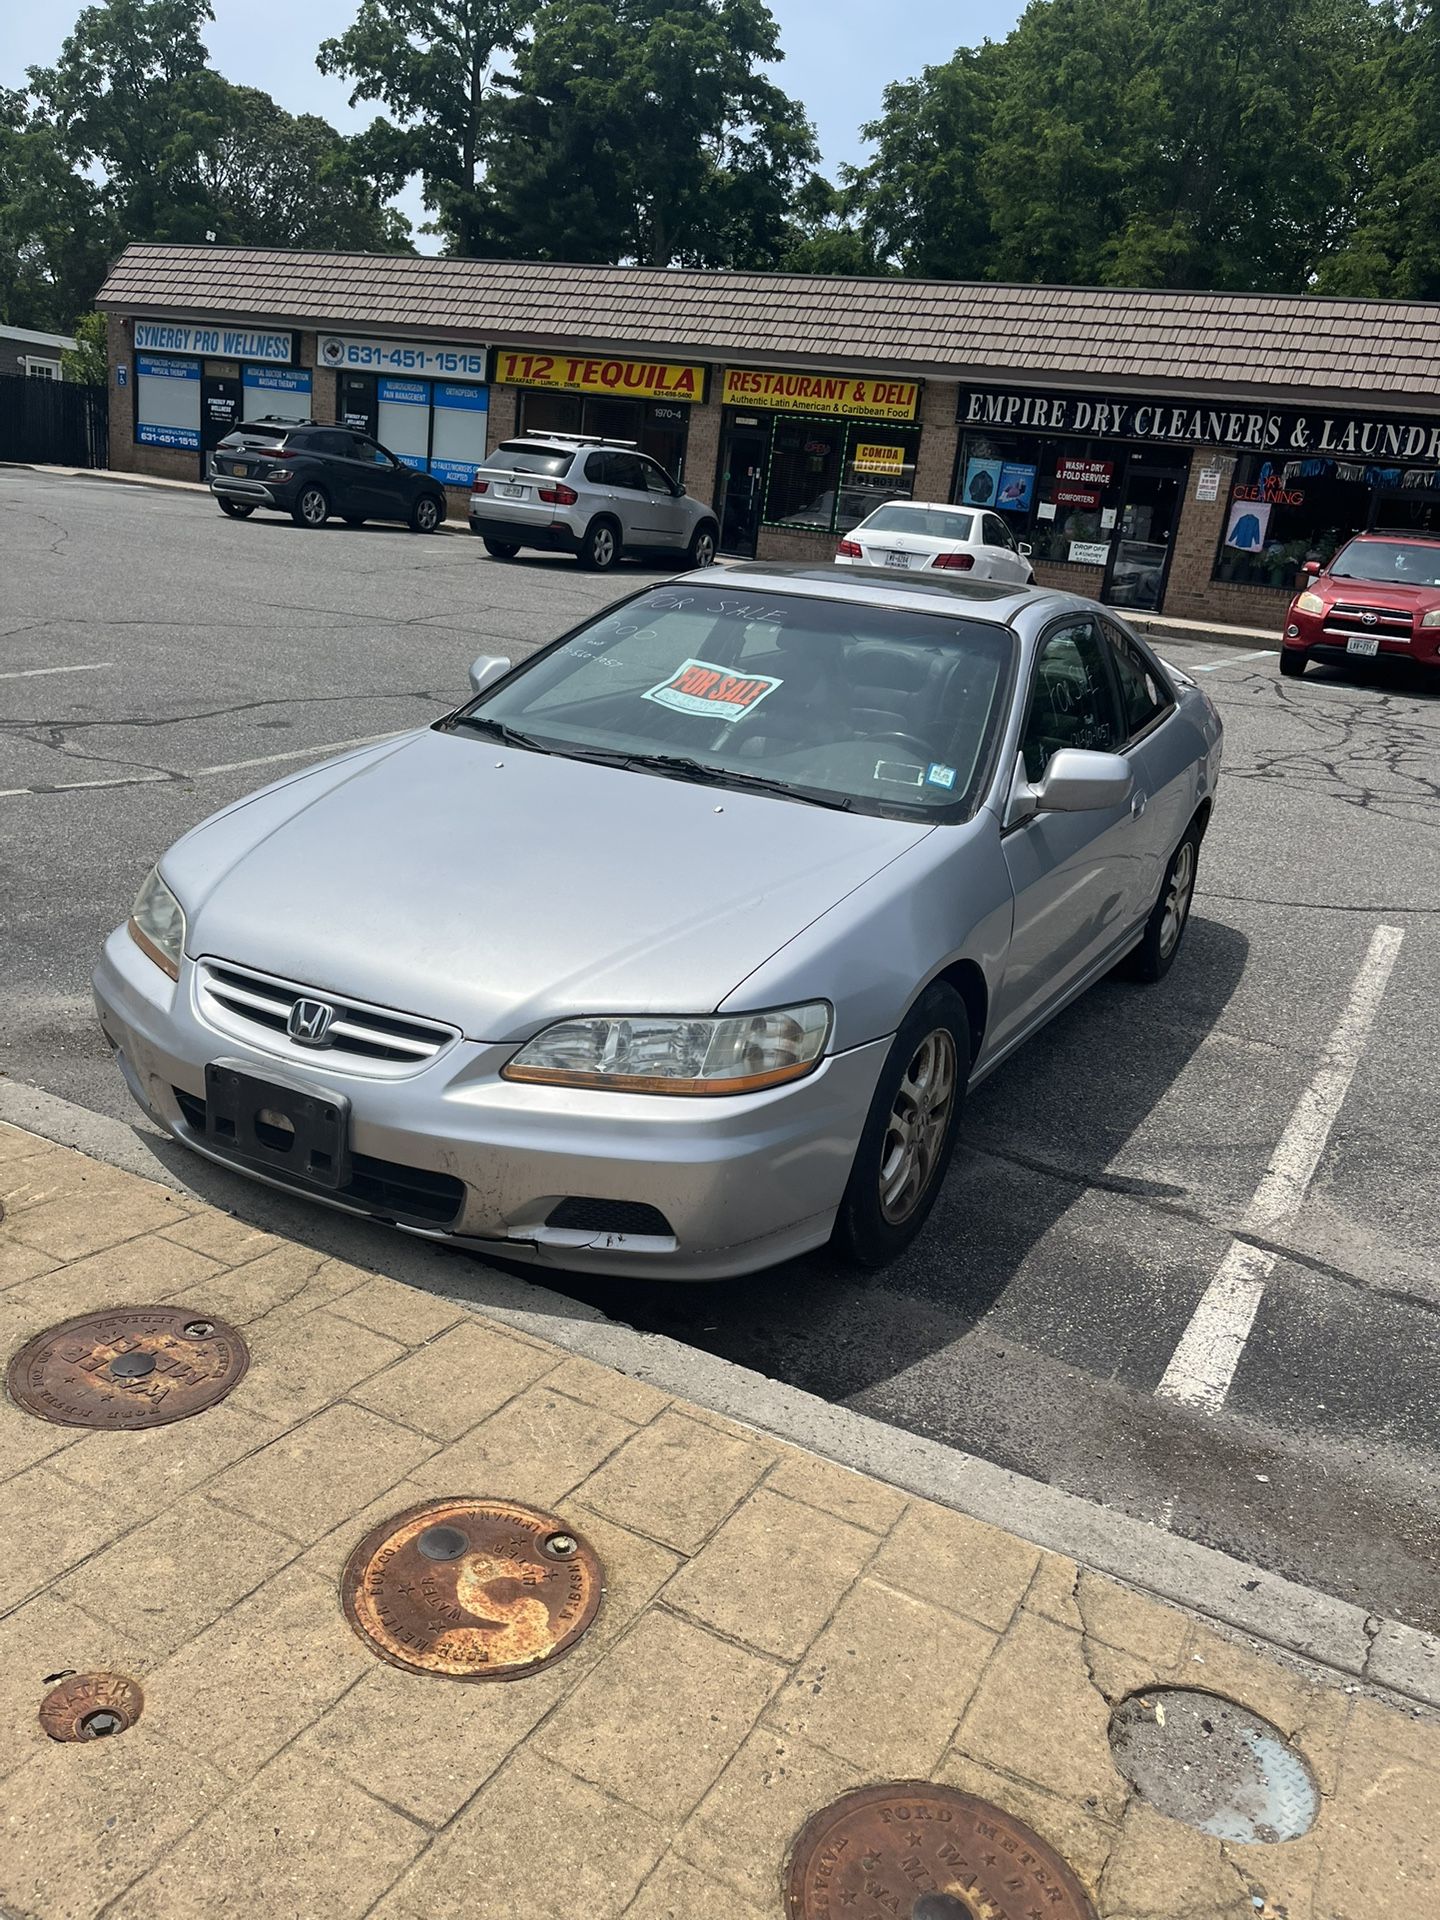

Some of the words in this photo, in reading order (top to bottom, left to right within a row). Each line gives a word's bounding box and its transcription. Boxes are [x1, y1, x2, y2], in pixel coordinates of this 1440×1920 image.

[136, 325, 191, 350] SYNERGY
[193, 331, 219, 352] PRO
[224, 332, 290, 359] WELLNESS
[347, 346, 482, 373] 631-451-1515
[505, 355, 554, 379] 112
[567, 359, 695, 392] TEQUILA
[505, 377, 535, 385] BREAKFAST
[728, 371, 850, 401] RESTAURANT
[853, 382, 866, 402] &
[872, 383, 916, 406] DELI
[654, 408, 682, 420] 1970-4
[730, 394, 768, 406] Authentic
[770, 398, 790, 408] Latin
[792, 400, 831, 412] American
[832, 403, 840, 413] &
[841, 404, 885, 417] Caribbean
[887, 408, 909, 418] Food
[966, 393, 1067, 428] EMPIRE
[1072, 402, 1129, 433] DRY
[1134, 405, 1282, 446] CLEANERS
[1290, 418, 1310, 447] &
[141, 433, 198, 446] 631-451-1515
[862, 446, 899, 460] COMIDA
[1056, 470, 1062, 479] &
[1062, 471, 1080, 480] FOLD
[1080, 473, 1110, 484] SERVICE
[1065, 461, 1085, 471] WASH
[1090, 464, 1105, 473] DRY
[1058, 492, 1095, 504] COMFORTERS
[1233, 484, 1304, 505] CLEANING
[1074, 543, 1094, 551] DROP
[629, 594, 694, 609] FOR
[706, 600, 788, 624] SALE
[671, 666, 720, 696] FOR
[708, 676, 768, 705] SALE
[467, 1510, 542, 1533] INDIANA
[370, 1566, 386, 1596] BOX
[558, 1557, 582, 1620] WABASH
[421, 1576, 462, 1621] WATER
[379, 1608, 430, 1652] METER
[877, 1806, 953, 1824] FORD
[974, 1822, 1064, 1904] METER
